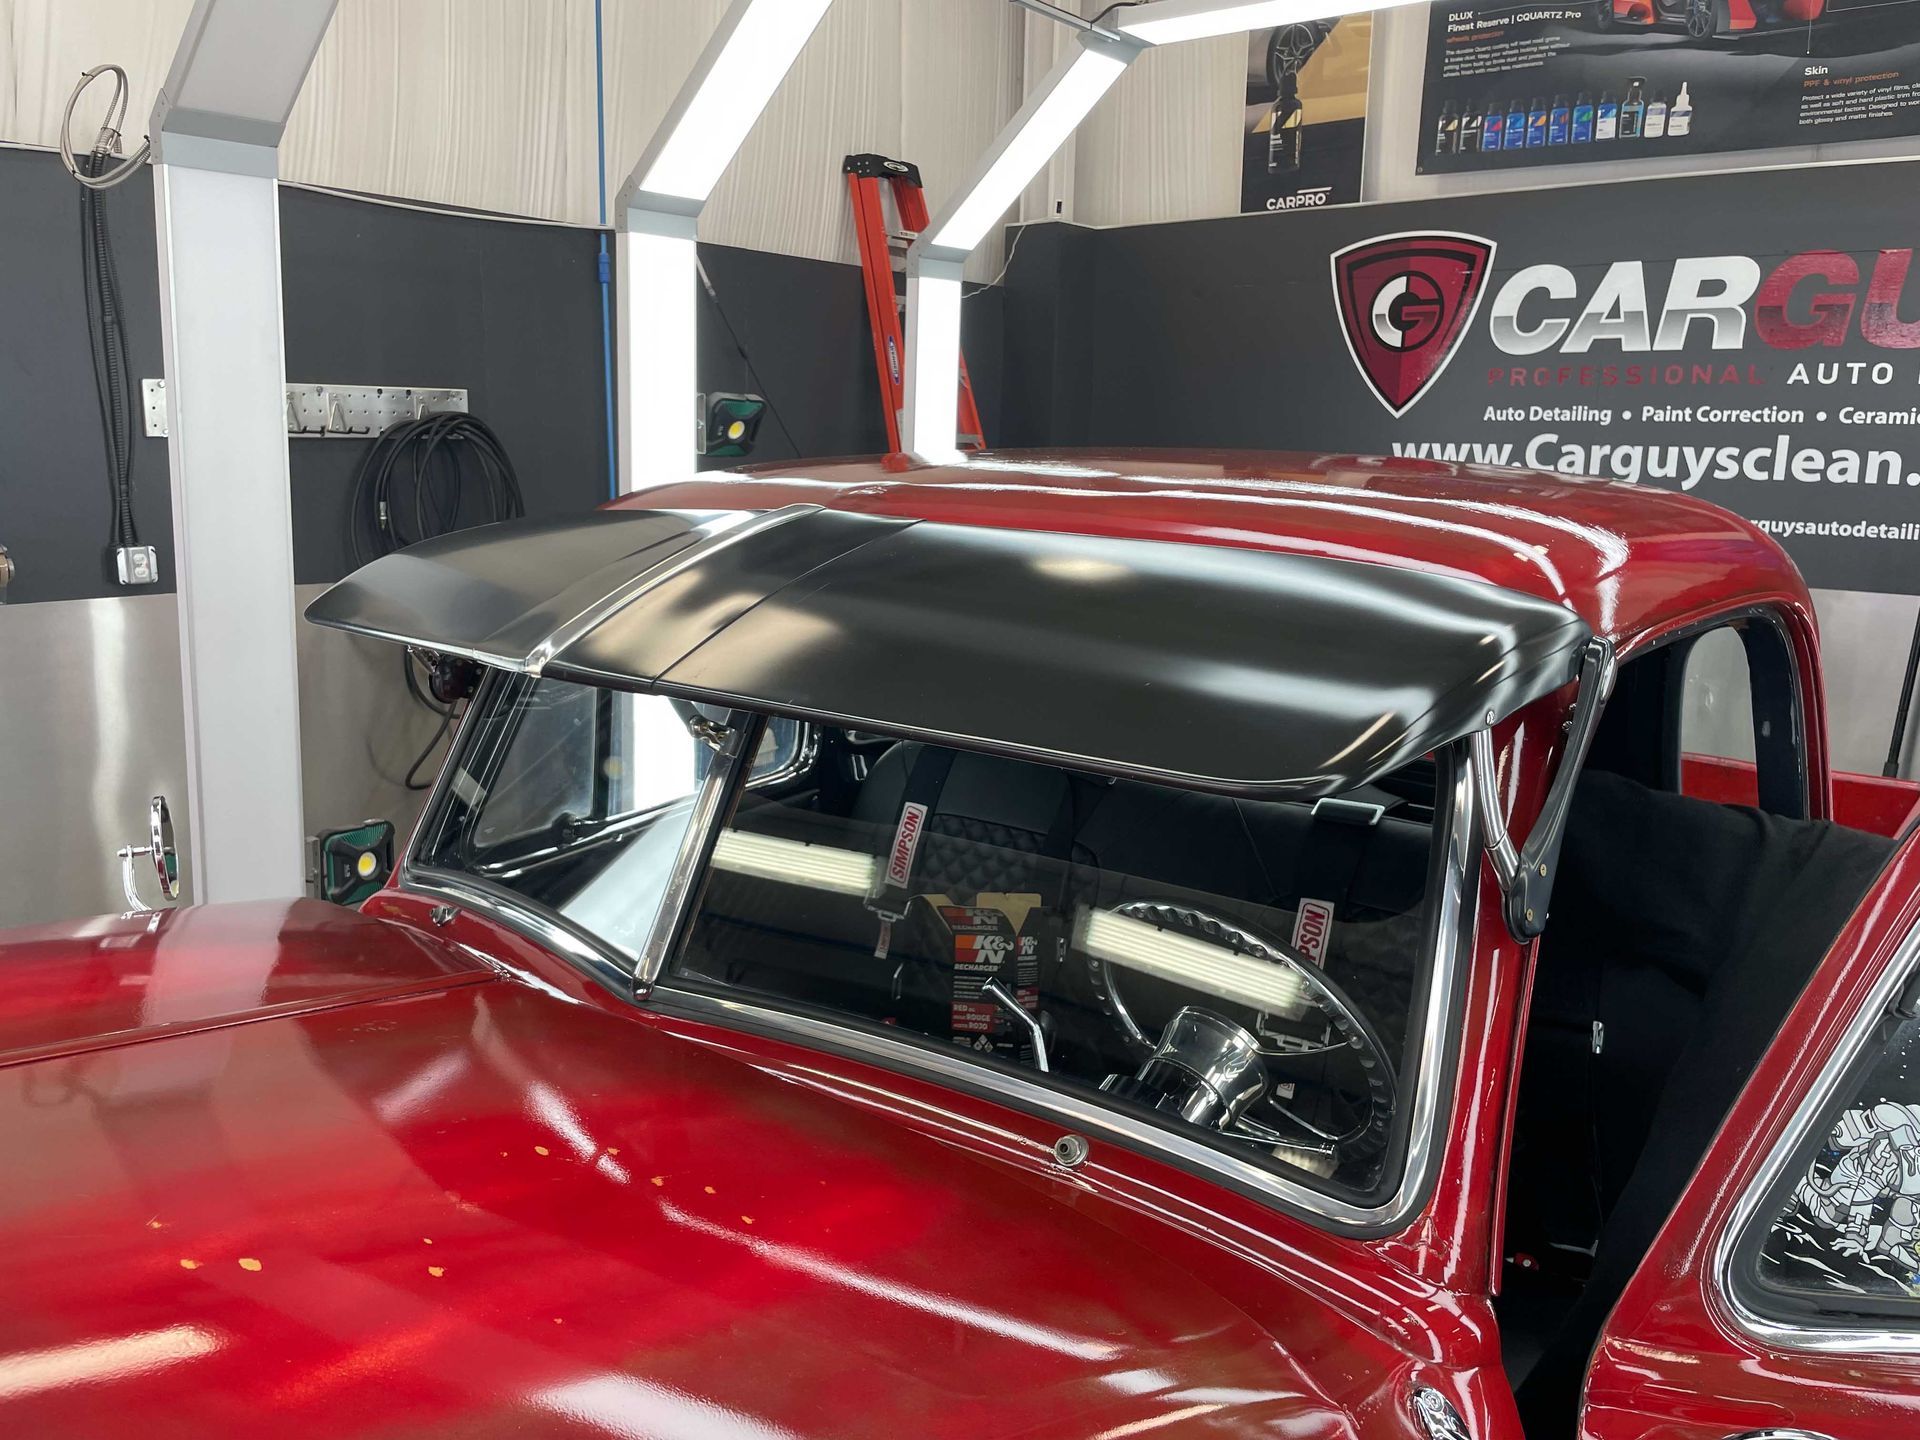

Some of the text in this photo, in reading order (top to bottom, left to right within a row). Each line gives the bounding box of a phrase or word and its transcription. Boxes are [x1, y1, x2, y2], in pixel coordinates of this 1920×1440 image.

[1447, 22, 1474, 32] Finest
[1476, 17, 1510, 29] Reserve
[1516, 11, 1562, 22] CQUARTZ
[1564, 11, 1582, 19] Pro
[1448, 11, 1473, 22] DLUX
[1805, 65, 1828, 76] Skin
[1854, 72, 1899, 83] protection
[1266, 193, 1327, 210] CARPRO
[1488, 364, 1766, 387] PROFESSIONAL
[1786, 362, 1893, 385] AUTO
[1483, 406, 1525, 421] Auto
[1529, 406, 1612, 425] Detailing
[1642, 406, 1692, 422] Paint
[1696, 406, 1804, 423] Correction
[892, 811, 919, 879] SIMPSON
[1298, 909, 1326, 962] PSON
[973, 935, 1014, 963] K&N
[953, 963, 999, 972] RECHARGER
[953, 1004, 968, 1012] RED
[966, 1013, 991, 1022] ROUGE
